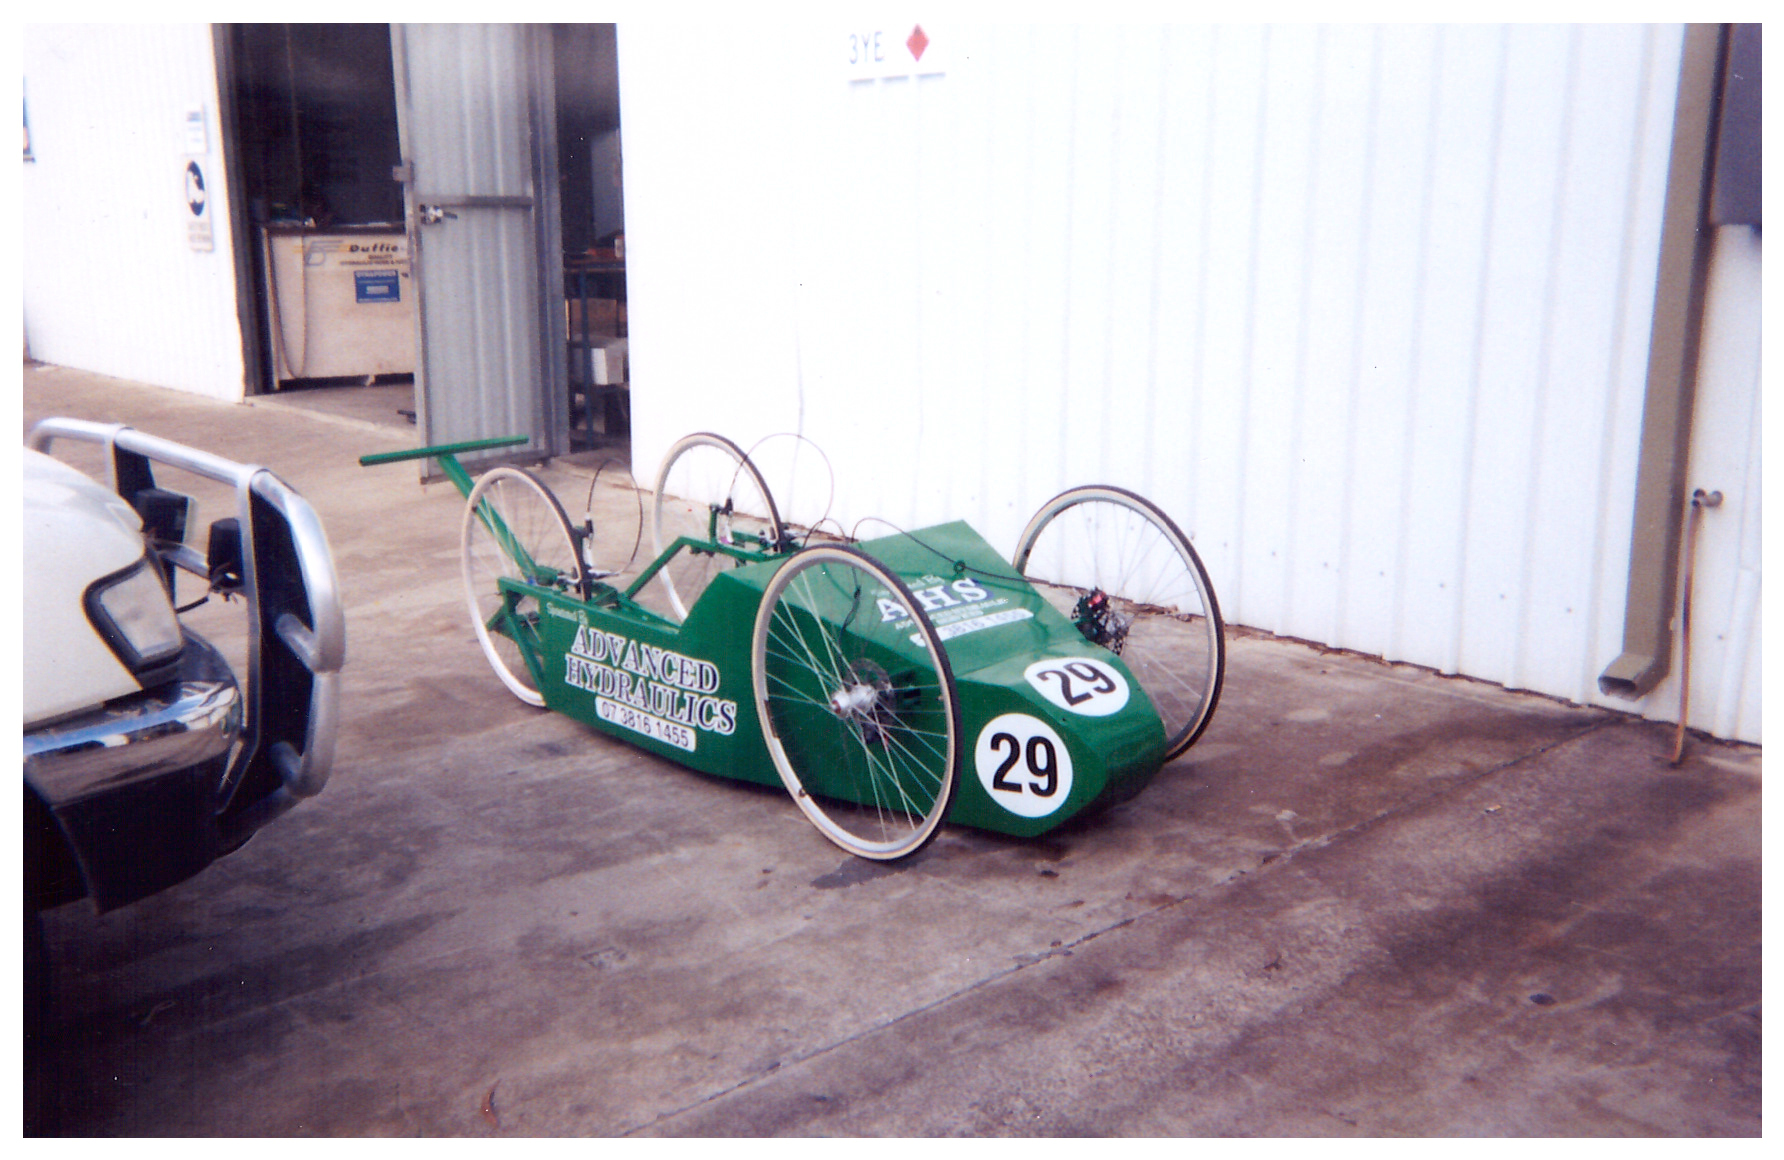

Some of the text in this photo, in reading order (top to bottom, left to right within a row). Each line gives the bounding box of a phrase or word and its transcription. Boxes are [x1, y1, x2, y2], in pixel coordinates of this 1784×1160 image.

[848, 31, 885, 65] 3YE
[876, 577, 993, 623] AHS
[570, 624, 720, 695] ADVANCED
[564, 653, 737, 735] HYDRAULICS
[1036, 662, 1117, 707] 29
[601, 701, 690, 748] 07 3816 1455
[990, 732, 1059, 798] 29
